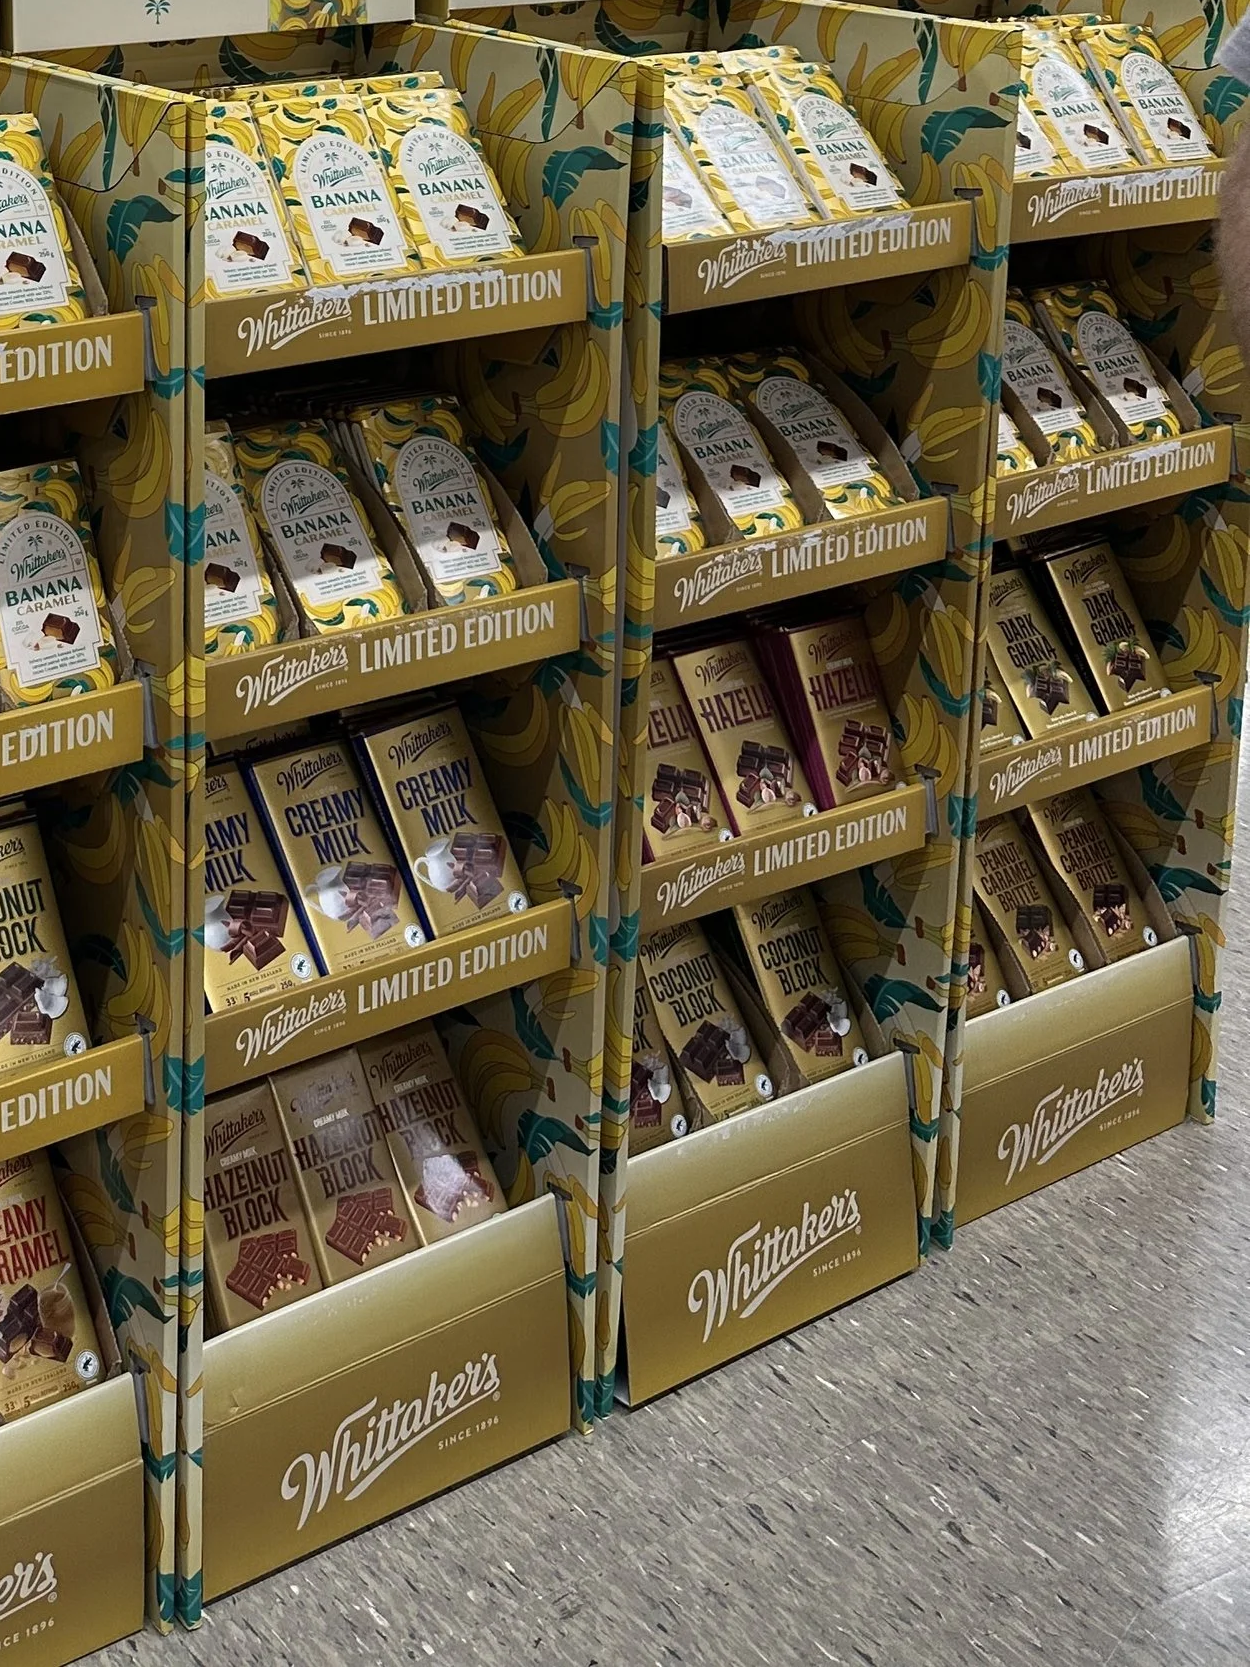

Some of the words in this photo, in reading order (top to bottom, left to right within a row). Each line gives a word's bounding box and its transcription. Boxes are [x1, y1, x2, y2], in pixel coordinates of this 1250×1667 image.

[1138, 96, 1183, 110] BANANA
[816, 140, 867, 155] BANANA
[311, 189, 382, 209] BANANA
[417, 178, 486, 197] BANANA
[470, 268, 563, 314] EDITION
[0, 334, 113, 385] EDITION
[1094, 355, 1140, 373] BANANA
[694, 437, 753, 460] BANANA
[1155, 441, 1216, 478] EDITION
[411, 491, 477, 515] BANANA
[280, 511, 351, 540] BANANA
[771, 533, 849, 578] LIMITED
[854, 516, 927, 563] EDITION
[5, 576, 83, 608] BANANA
[16, 594, 80, 617] CARAMEL
[1082, 589, 1123, 620] DARK
[997, 613, 1041, 644] DARK
[1090, 612, 1135, 646] GHANA
[236, 644, 349, 716] Whittaker's
[360, 624, 457, 674] LIMITED
[464, 600, 555, 649] EDITION
[1006, 636, 1057, 669] GHANA
[698, 682, 774, 733] HAZELLA
[2, 708, 114, 766] EDITION
[990, 745, 1062, 804] Whittaker's
[1069, 726, 1132, 768] LIMITED
[1137, 704, 1197, 746] EDITION
[395, 756, 473, 811] CREAMY
[284, 788, 365, 838] CREAMY
[421, 794, 478, 838] MILK
[311, 823, 372, 866] MILK
[1056, 821, 1099, 852] PEANUT
[1060, 841, 1116, 875] CARAMEL
[657, 850, 746, 916] Whittaker's
[753, 832, 831, 876] LIMITED
[835, 806, 907, 850] EDITION
[1076, 861, 1118, 892] BRITTLE
[757, 924, 825, 971] COCONUT
[236, 988, 348, 1068] Whittaker's
[357, 957, 453, 1014] LIMITED
[460, 924, 549, 981] EDITION
[650, 952, 718, 1004] COCONUT
[772, 958, 830, 998] BLOCK
[668, 986, 726, 1029] BLOCK
[1, 1066, 113, 1131] EDITION
[998, 1058, 1145, 1186] Whittaker's
[319, 1149, 383, 1199] BLOCK
[223, 1189, 290, 1240] BLOCK
[687, 1188, 861, 1344] Whittaker's
[842, 1248, 862, 1264] 1896
[281, 1352, 501, 1532] Whittaker's
[437, 1428, 472, 1451] SINCE
